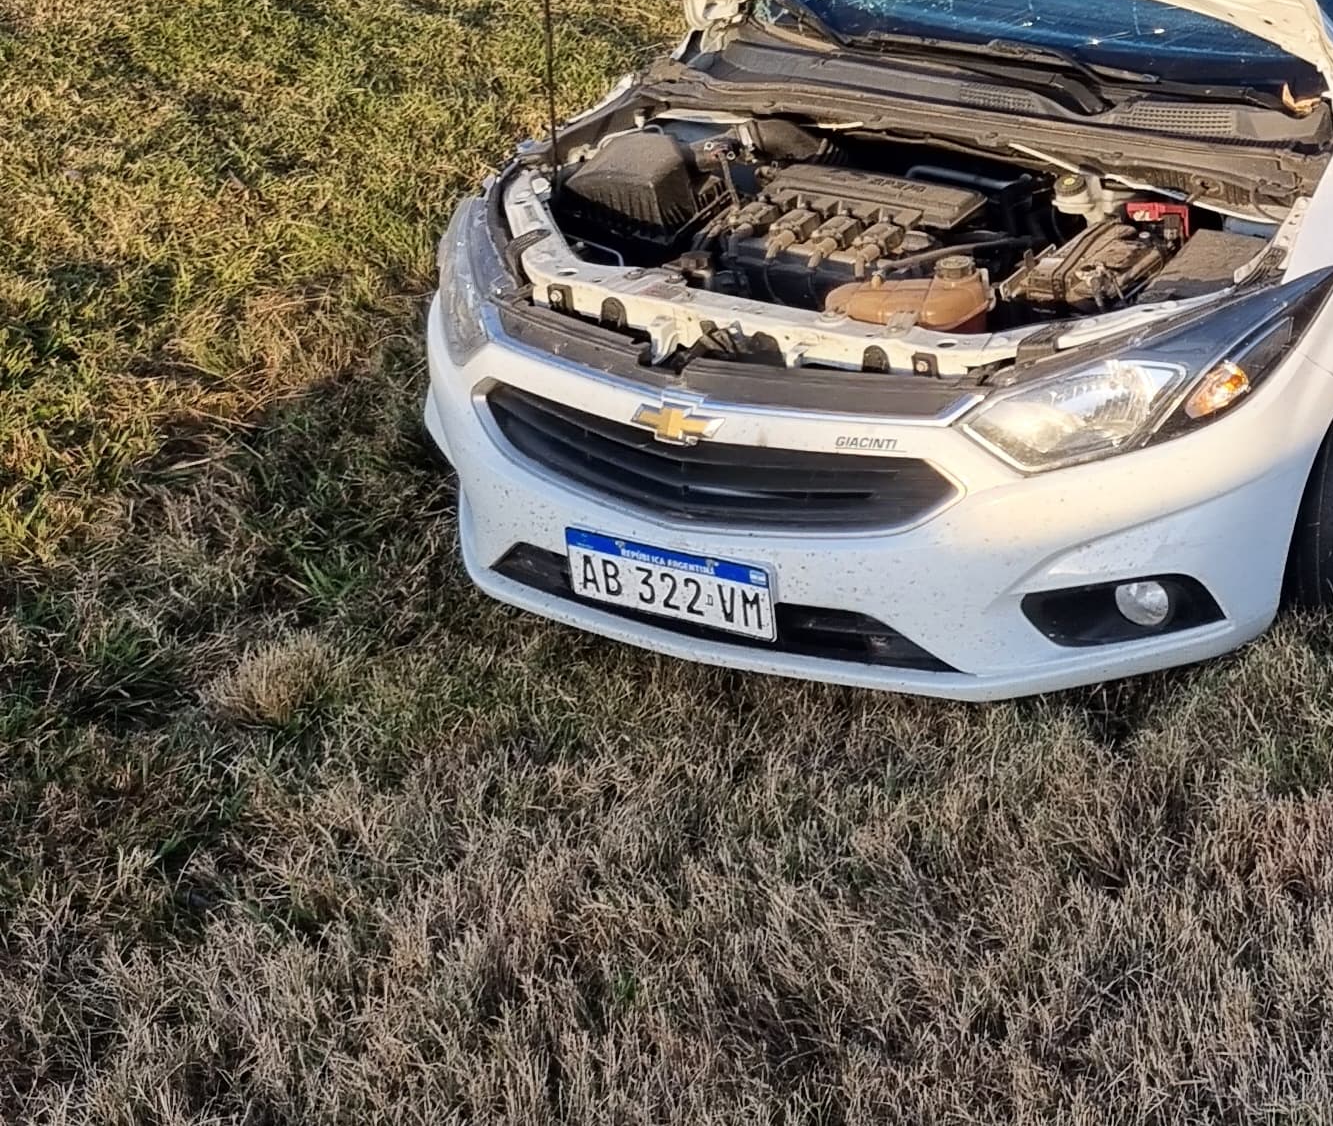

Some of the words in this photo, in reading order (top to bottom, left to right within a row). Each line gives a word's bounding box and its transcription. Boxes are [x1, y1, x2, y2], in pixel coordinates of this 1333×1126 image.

[835, 436, 898, 450] GIACINTI
[582, 554, 623, 596] AB
[635, 566, 705, 617] 322
[717, 583, 763, 630] VM
